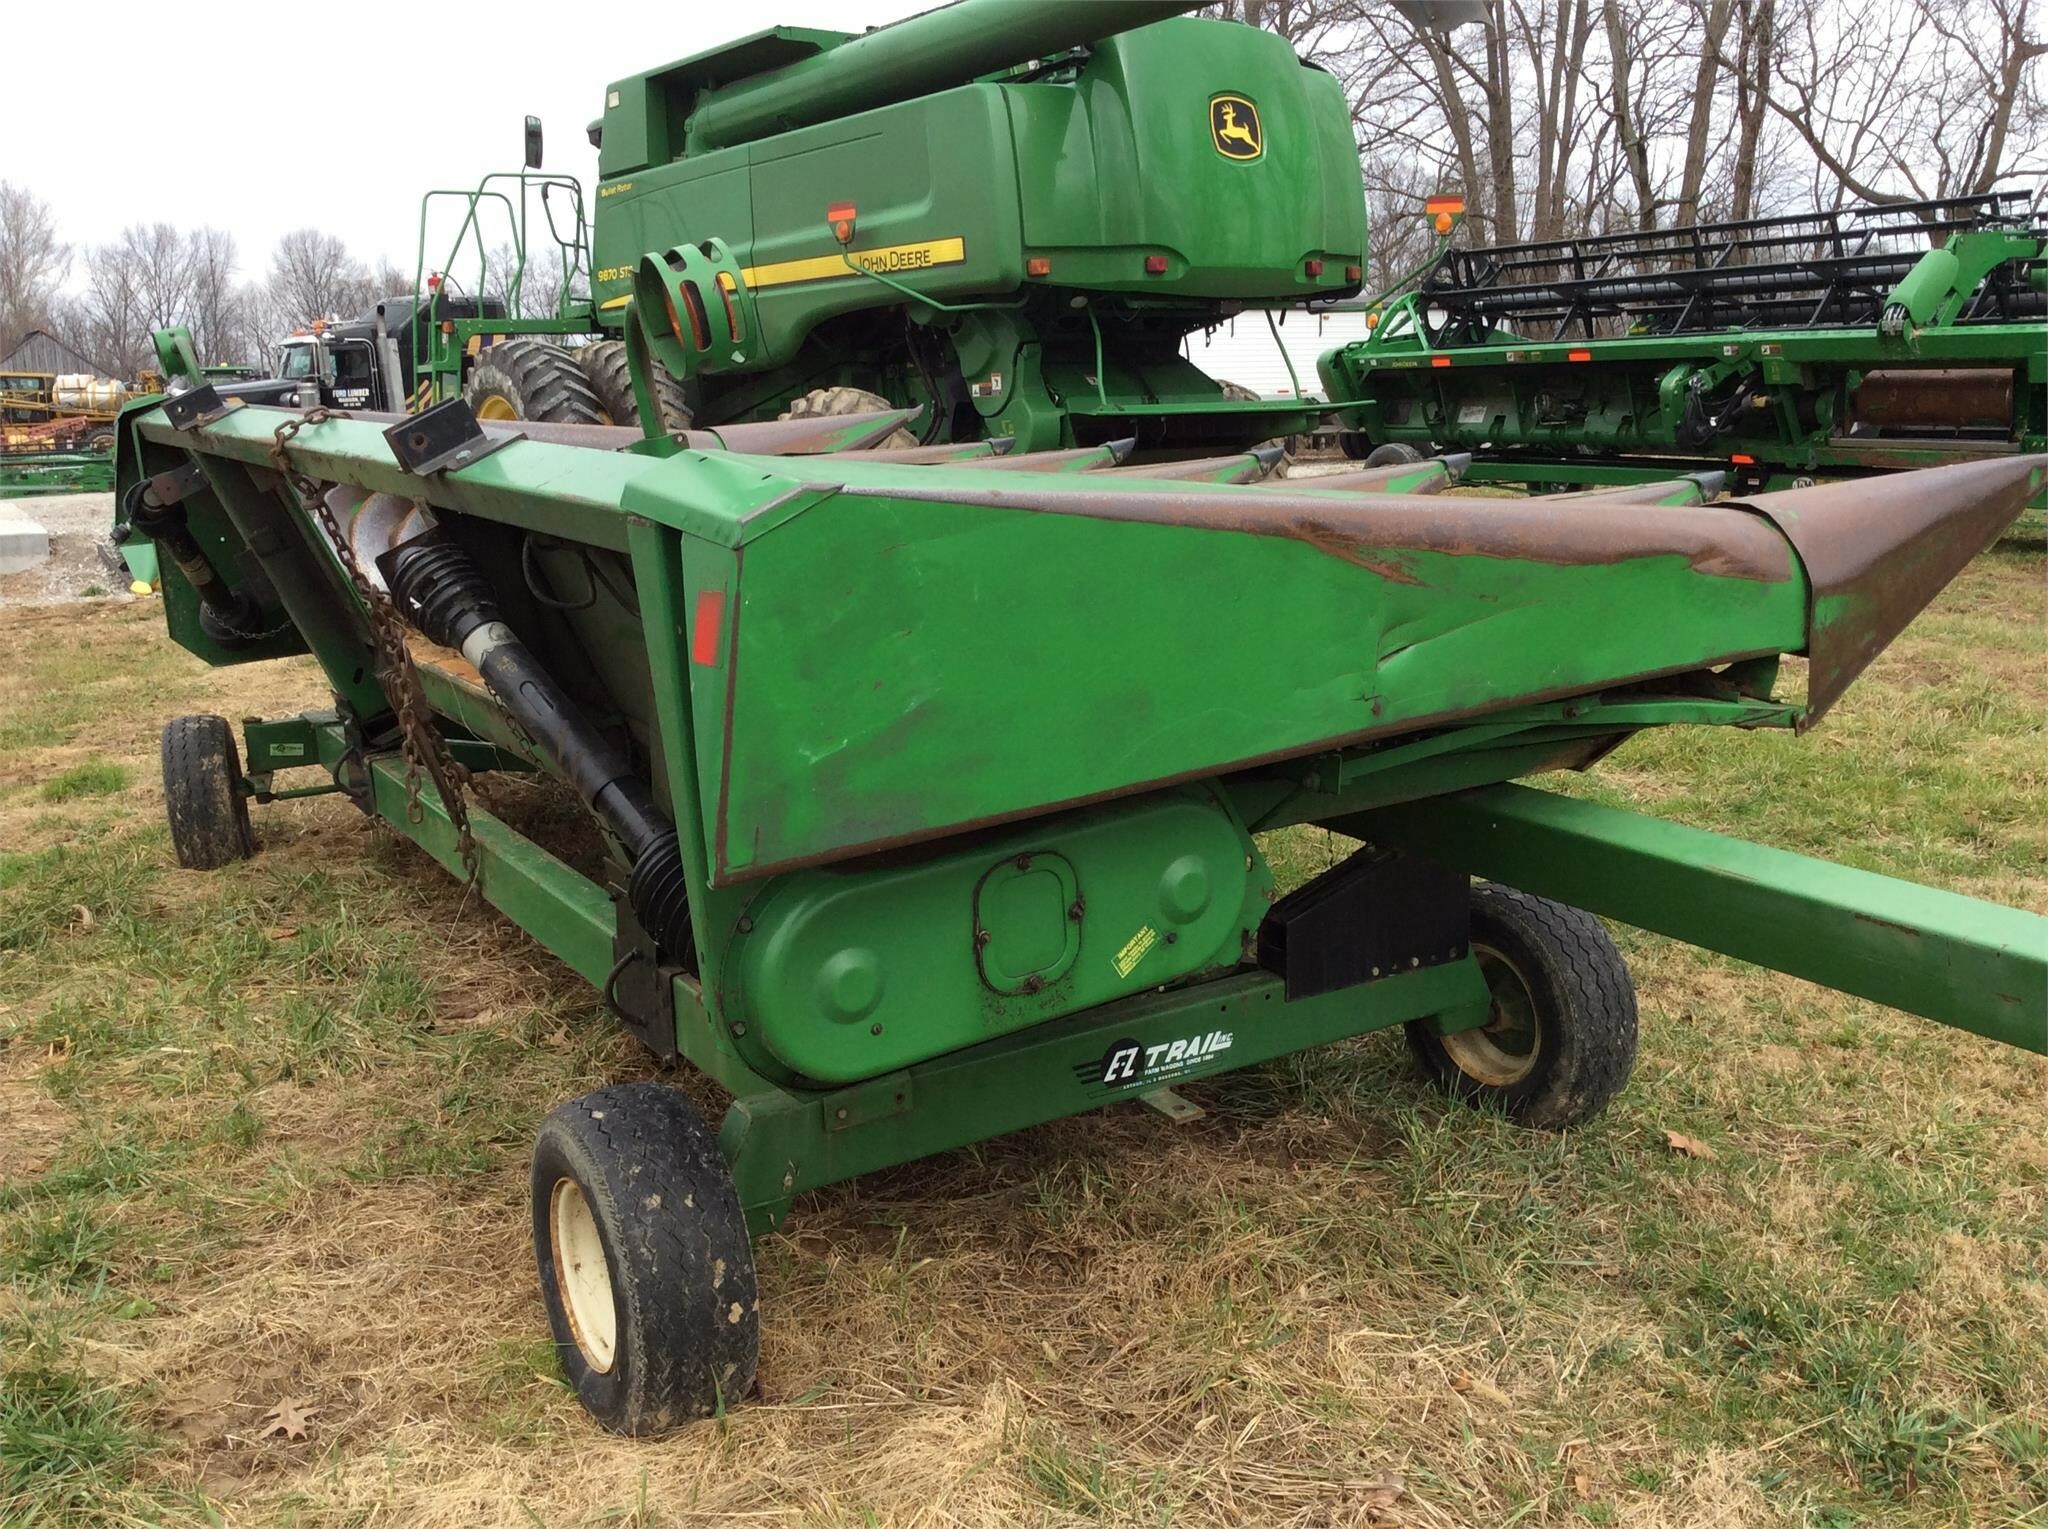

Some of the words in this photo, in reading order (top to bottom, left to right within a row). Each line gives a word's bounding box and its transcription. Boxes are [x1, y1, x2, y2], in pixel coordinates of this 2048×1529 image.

[858, 254, 888, 272] JOHN
[889, 249, 931, 269] DEERE
[598, 268, 617, 282] 9870
[1117, 925, 1148, 960] IMPORTANT
[1145, 1030, 1233, 1067] TRAIL
[1144, 1066, 1160, 1076] FARM
